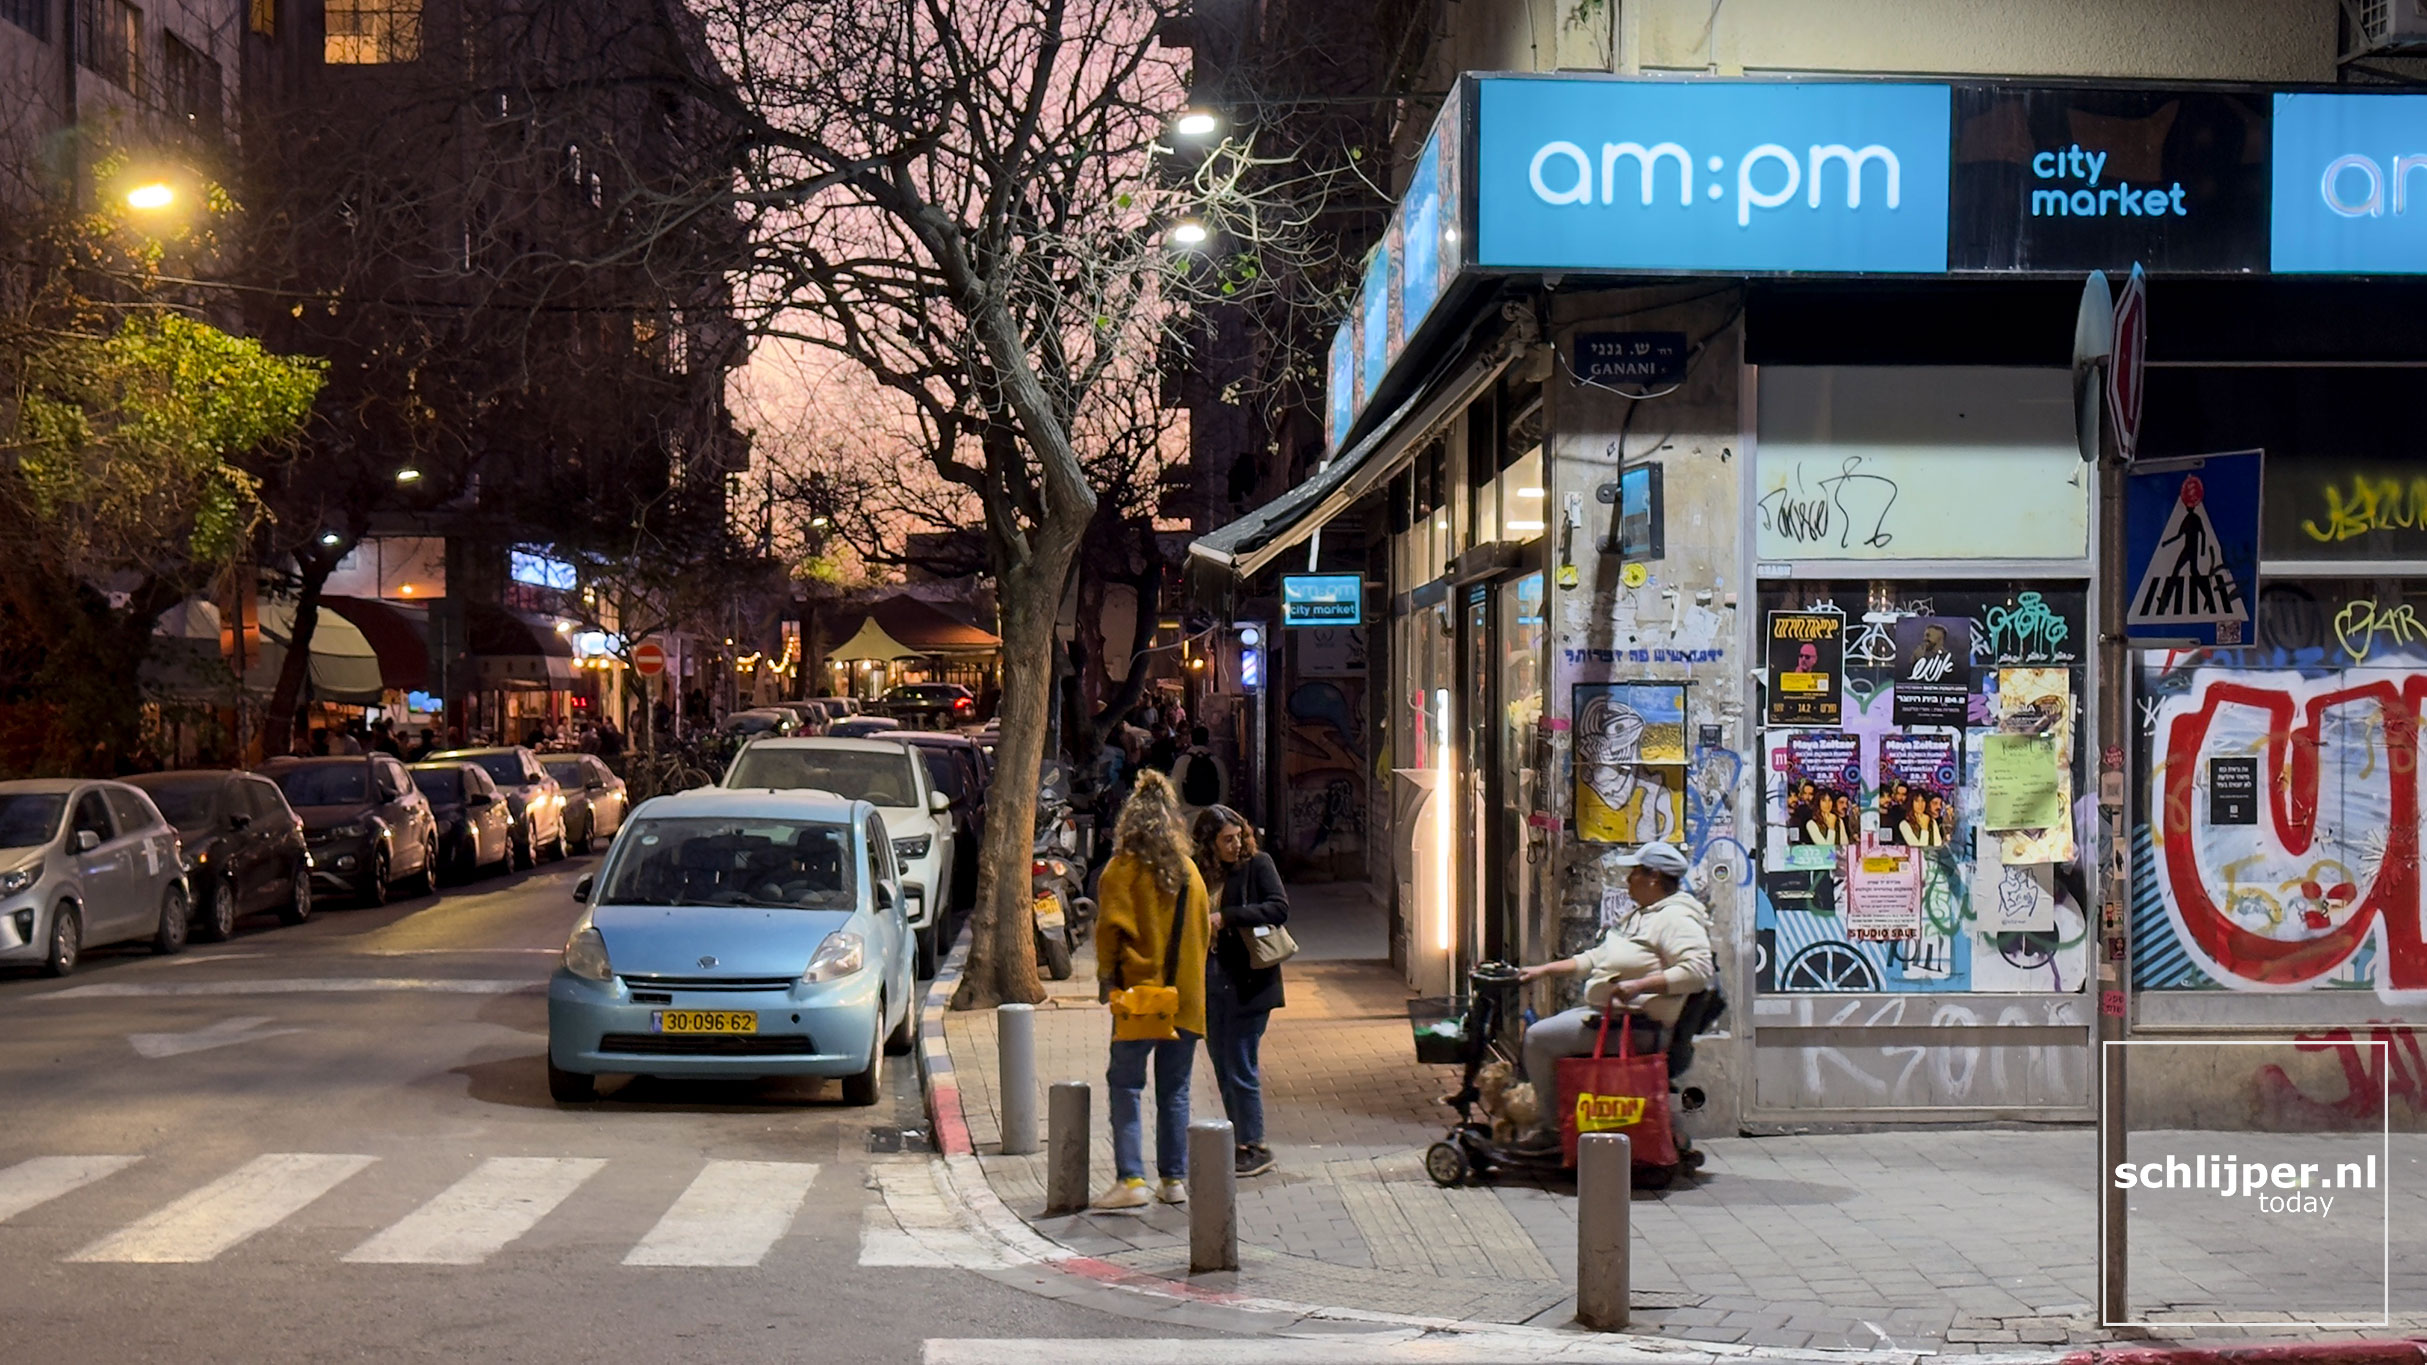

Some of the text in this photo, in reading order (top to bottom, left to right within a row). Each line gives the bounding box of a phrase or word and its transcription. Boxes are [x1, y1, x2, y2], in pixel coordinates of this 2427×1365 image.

[2032, 143, 2107, 184] city
[1529, 141, 1900, 227] am:pm
[2032, 182, 2187, 216] market
[1590, 363, 1655, 375] GANANI
[1291, 605, 1354, 616] city market
[1793, 740, 1818, 751] Maya
[1886, 741, 1911, 752] Maya
[1848, 928, 1917, 938] STUDIO SALE
